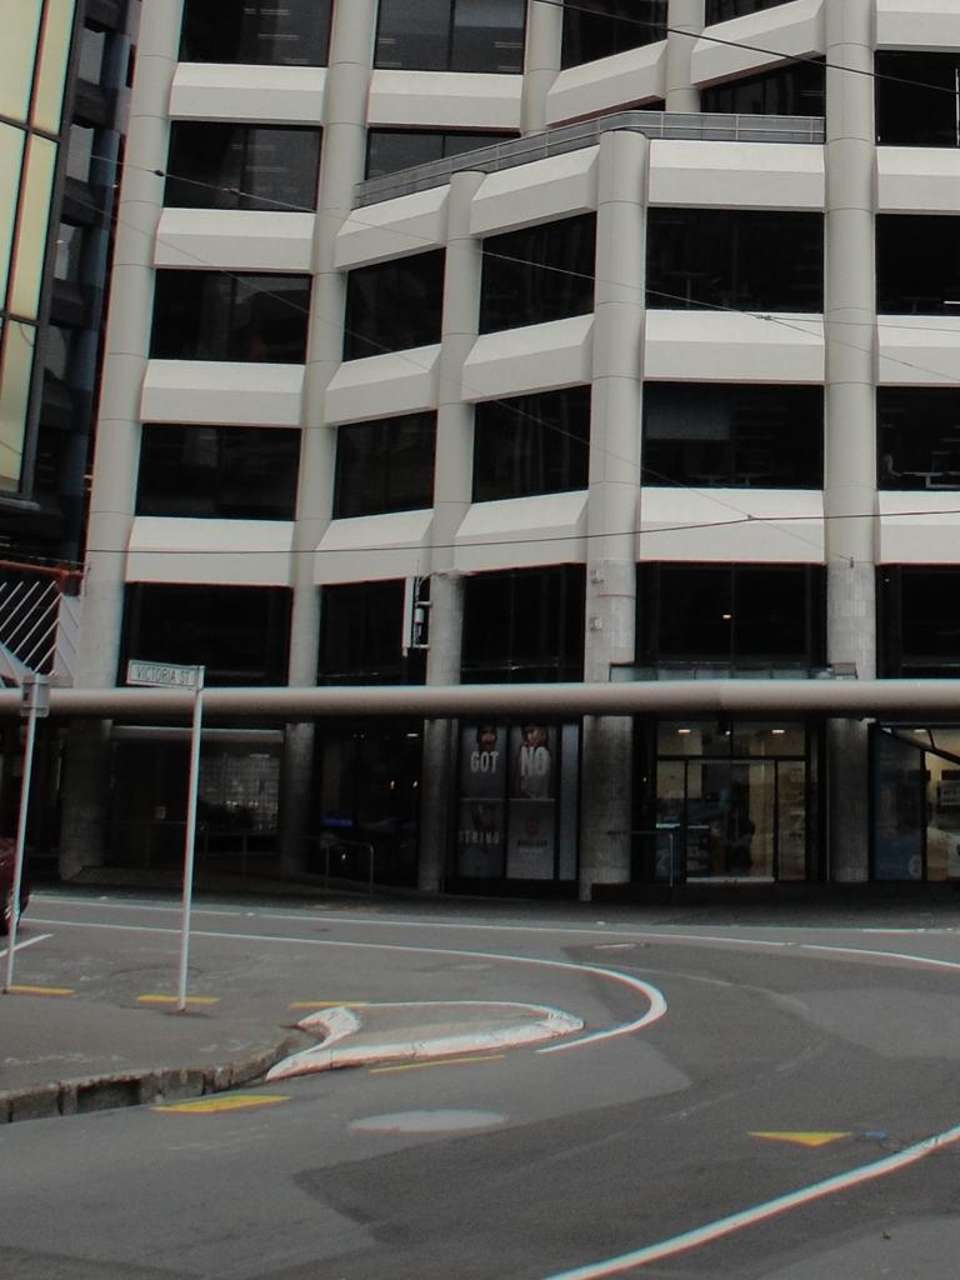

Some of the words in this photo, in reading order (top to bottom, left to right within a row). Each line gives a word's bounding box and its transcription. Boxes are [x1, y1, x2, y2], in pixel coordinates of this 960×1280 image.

[134, 664, 176, 681] VICTORIA
[180, 669, 192, 682] ST
[471, 750, 499, 774] GOT
[520, 746, 550, 776] NO
